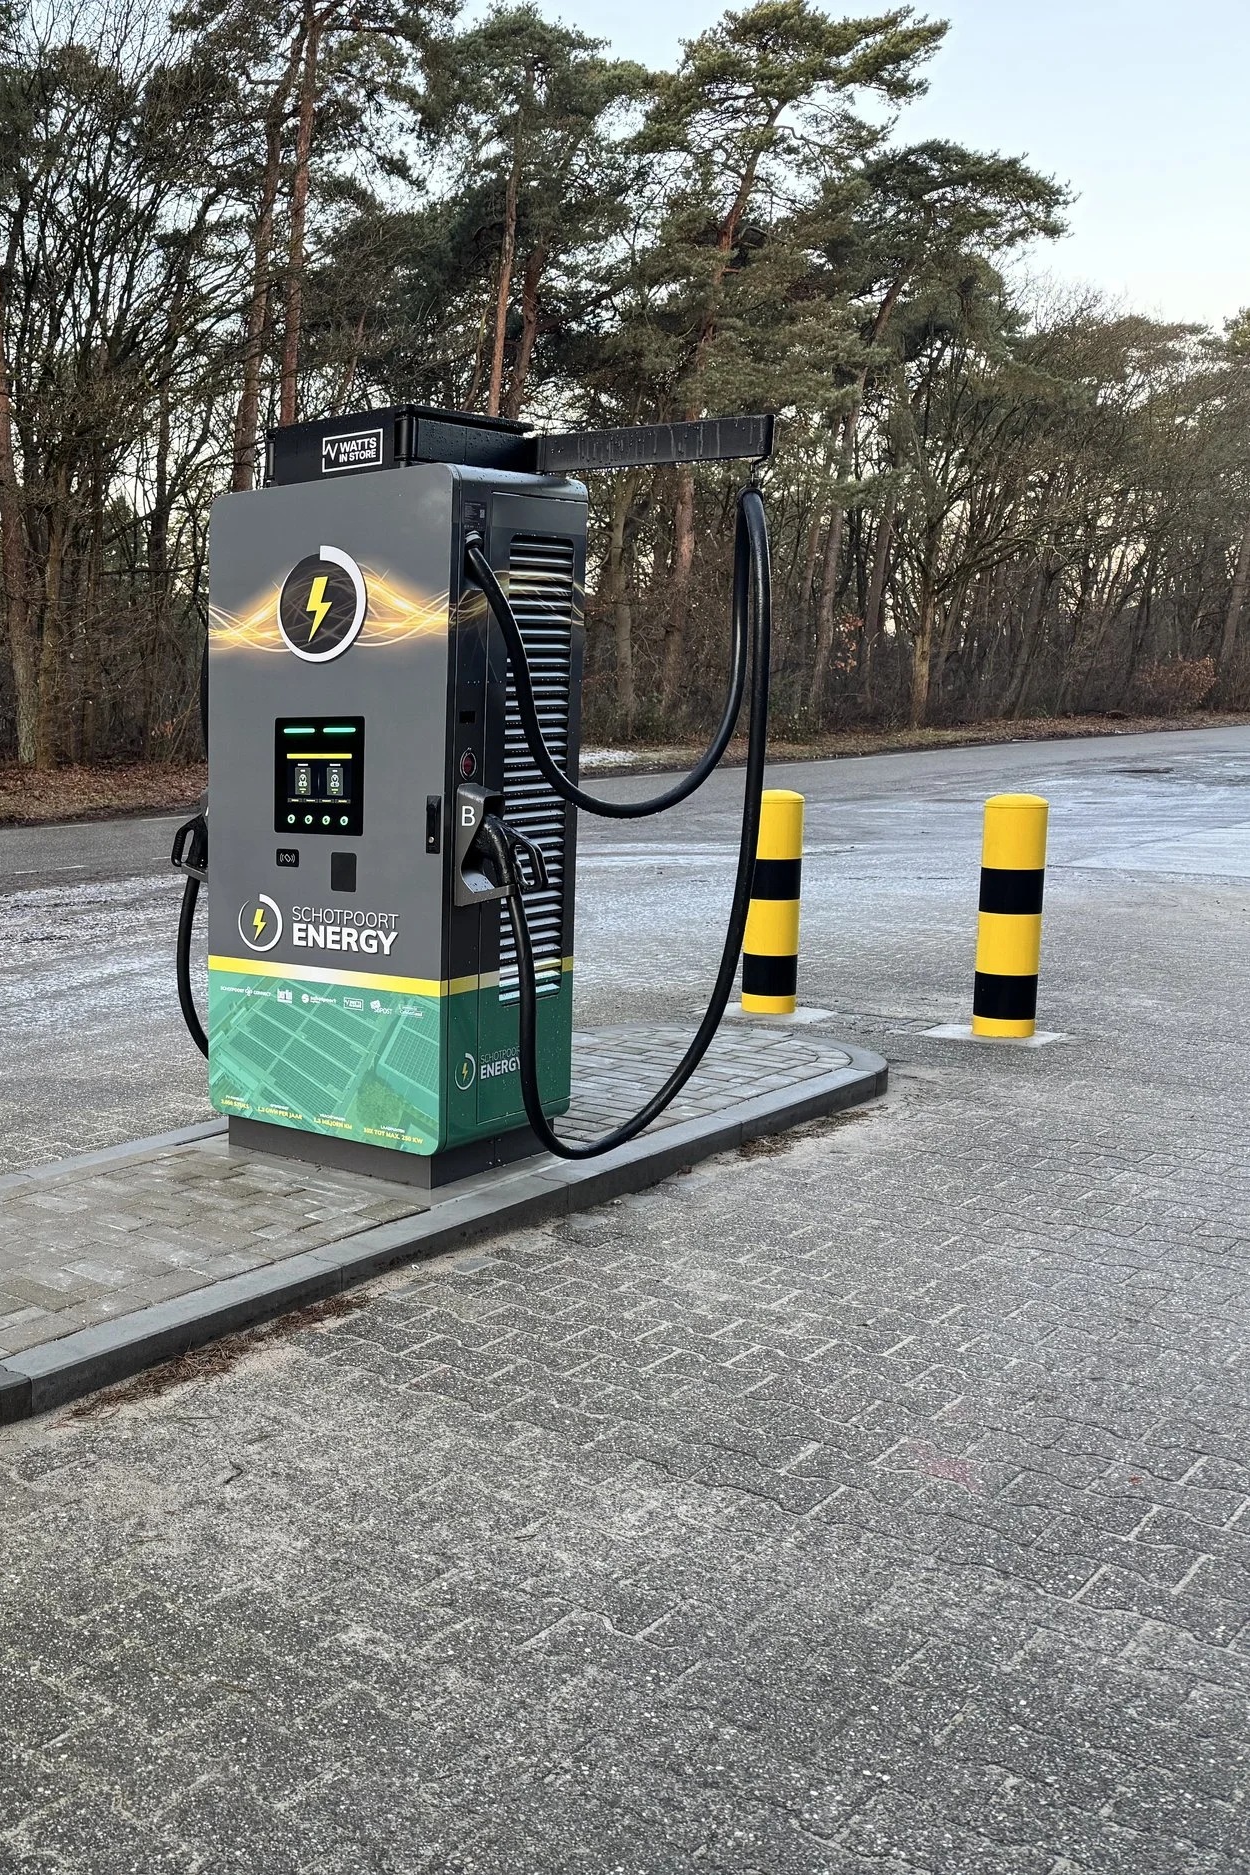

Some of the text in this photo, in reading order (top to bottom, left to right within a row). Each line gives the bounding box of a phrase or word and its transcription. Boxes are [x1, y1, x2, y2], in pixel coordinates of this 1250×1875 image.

[339, 449, 377, 463] IN STORE
[340, 437, 377, 453] WATTS
[461, 805, 476, 827] B
[292, 905, 399, 929] SCHOTPOORT
[293, 922, 399, 955] ENERGY
